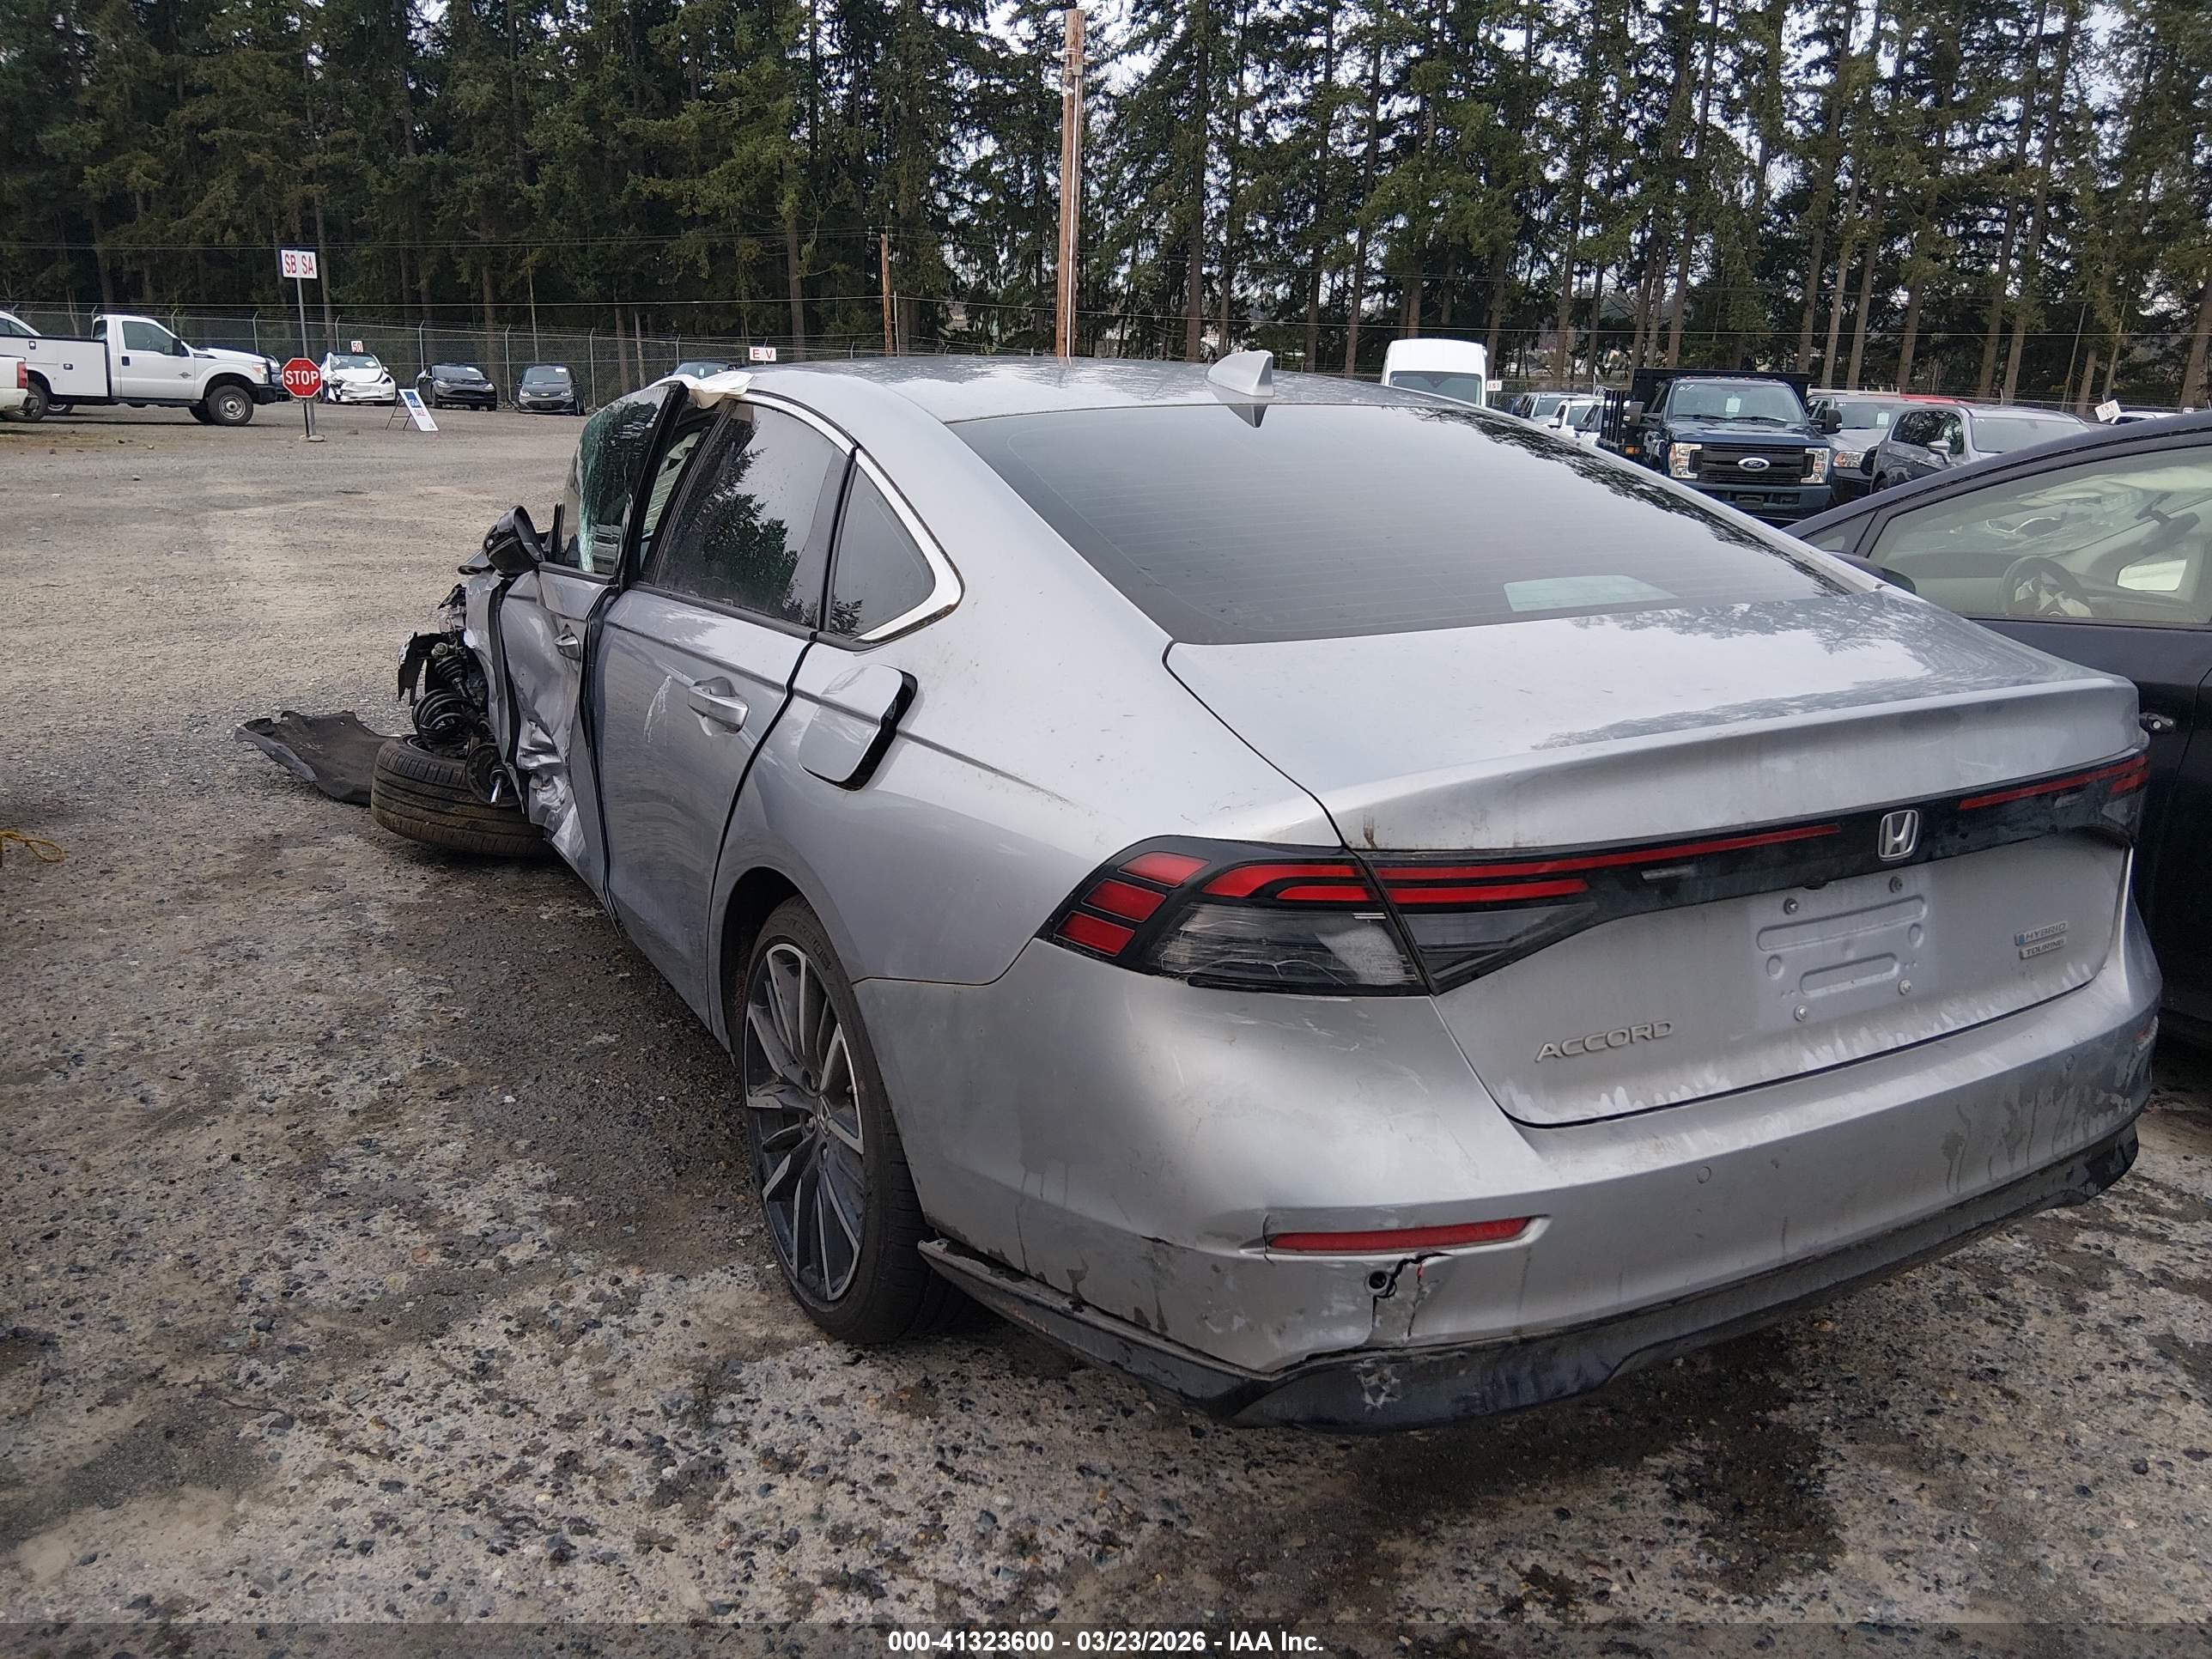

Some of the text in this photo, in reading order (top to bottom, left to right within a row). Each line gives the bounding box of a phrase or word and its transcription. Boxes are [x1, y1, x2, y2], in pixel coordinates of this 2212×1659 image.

[284, 254, 314, 275] SB SA
[285, 370, 319, 385] STOP
[2026, 922, 2067, 939] HYBRID
[2026, 938, 2066, 956] TOURING
[1534, 1020, 1674, 1063] ACCORD
